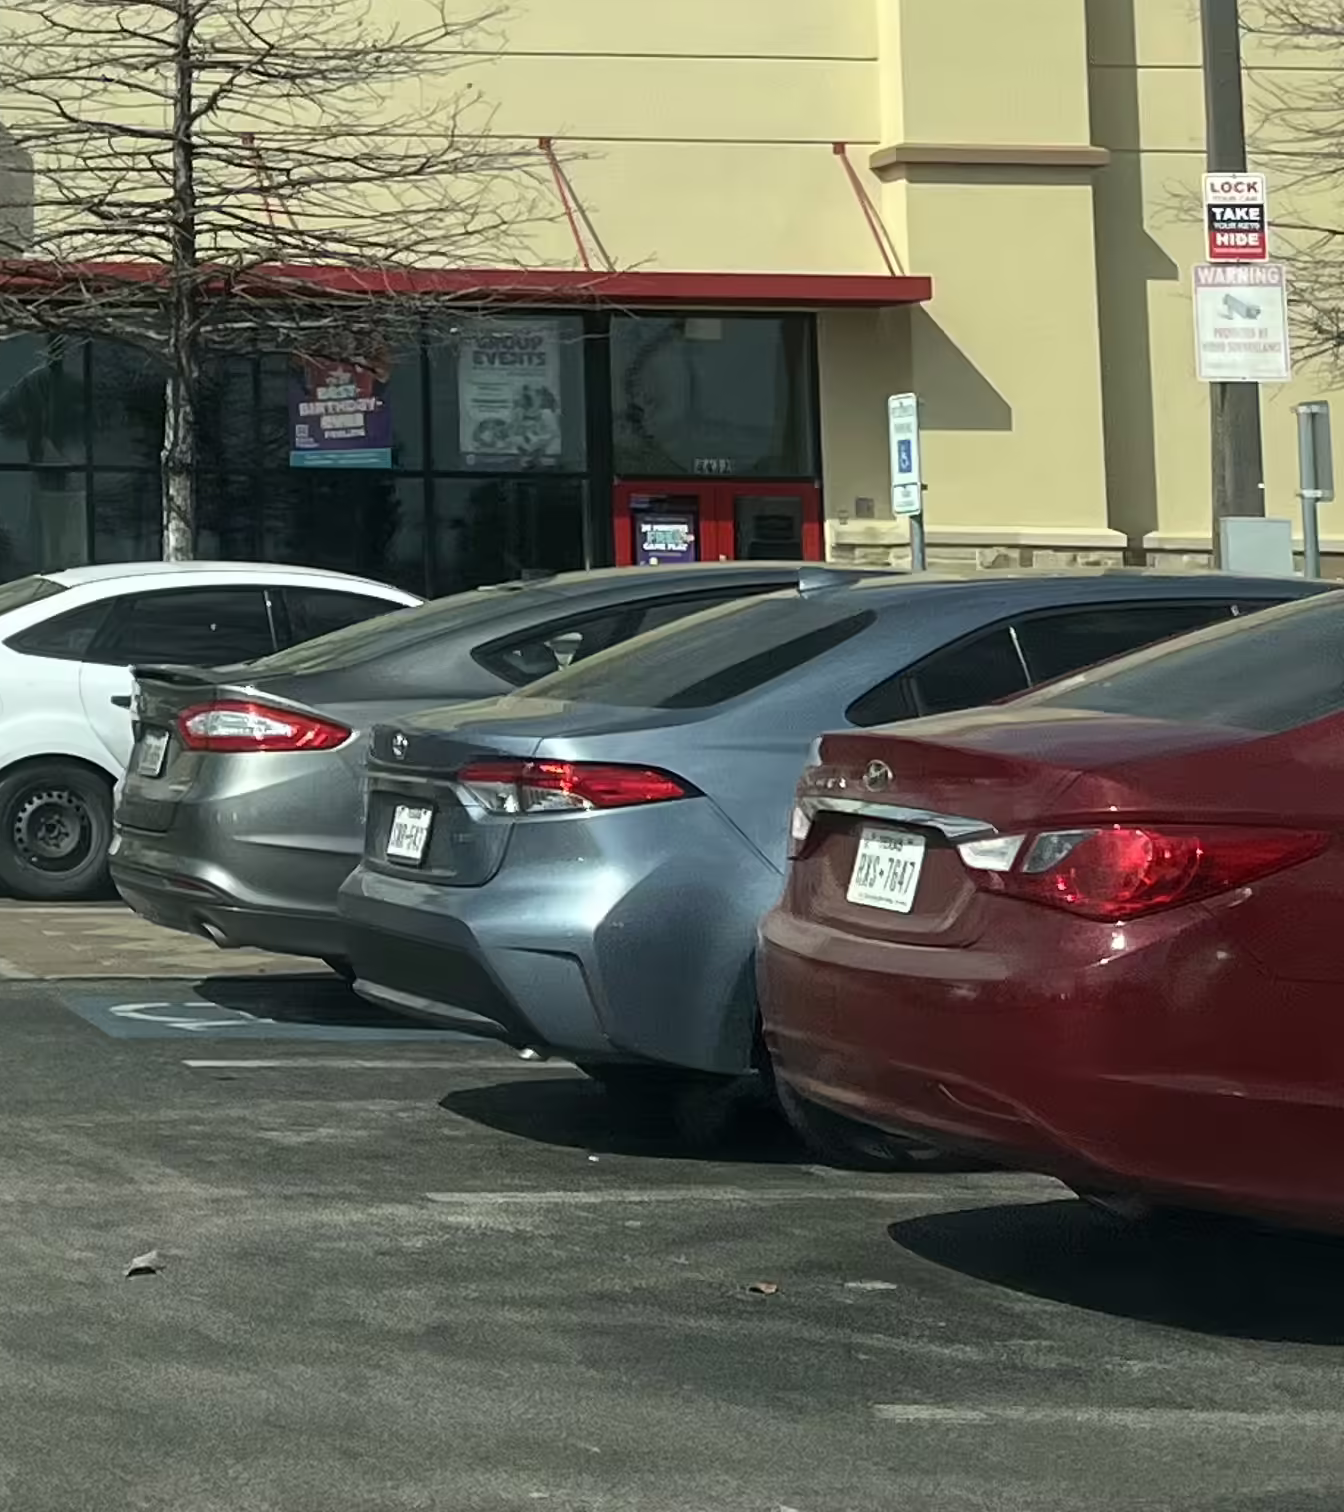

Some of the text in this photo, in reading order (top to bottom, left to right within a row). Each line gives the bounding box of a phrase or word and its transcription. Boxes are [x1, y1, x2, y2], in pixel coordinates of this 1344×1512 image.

[1210, 181, 1259, 193] LOCK
[1211, 207, 1261, 221] TAKE
[1215, 232, 1260, 246] HIDE
[1197, 266, 1280, 285] WARNING
[472, 350, 546, 367] EVENTS
